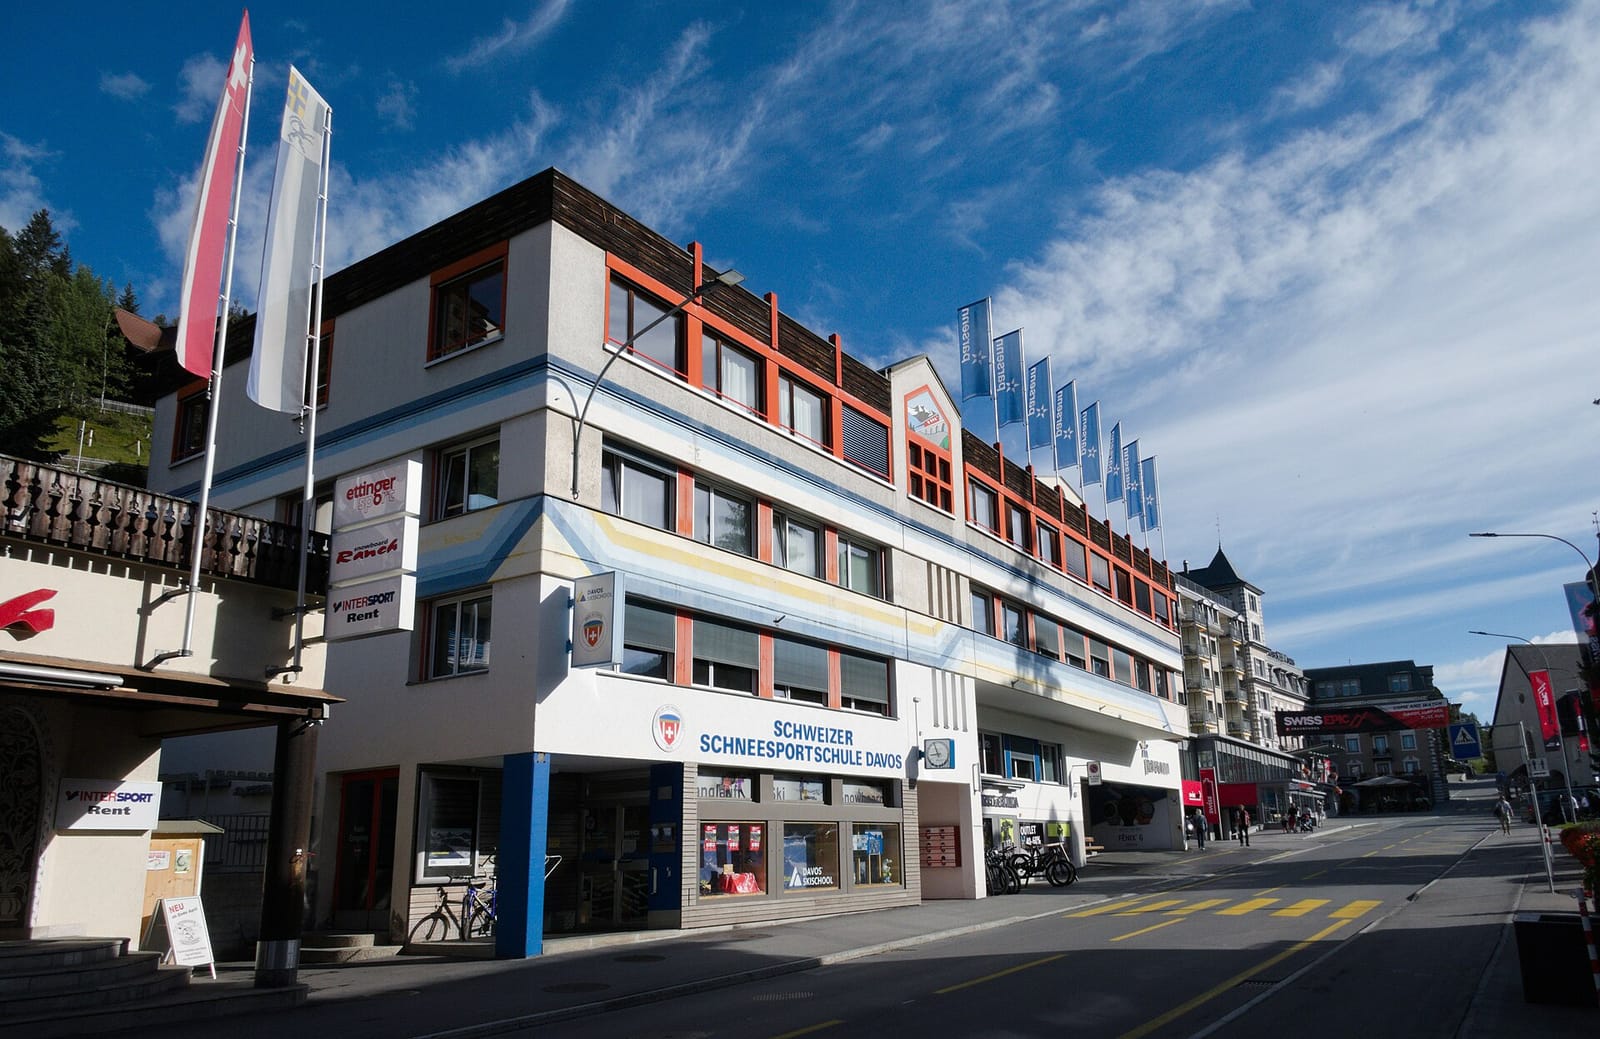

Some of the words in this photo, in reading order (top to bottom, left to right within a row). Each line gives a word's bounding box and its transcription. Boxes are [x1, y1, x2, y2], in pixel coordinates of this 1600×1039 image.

[346, 476, 397, 506] ettinger
[336, 538, 398, 564] Ranch
[342, 591, 395, 611] INTERSPORT
[347, 609, 380, 623] Rent
[1283, 715, 1324, 726] SWISS
[1324, 713, 1349, 726] EPIC
[773, 719, 854, 746] SCHWEIZER
[699, 733, 863, 767] SCHNEESPORTSCHULE
[865, 751, 903, 770] DAVOS
[79, 790, 154, 803] INTERSPORT
[87, 805, 132, 816] Rent
[802, 866, 823, 876] DAVOS
[802, 876, 834, 886] SKISCHOOL
[169, 902, 185, 914] NEU
